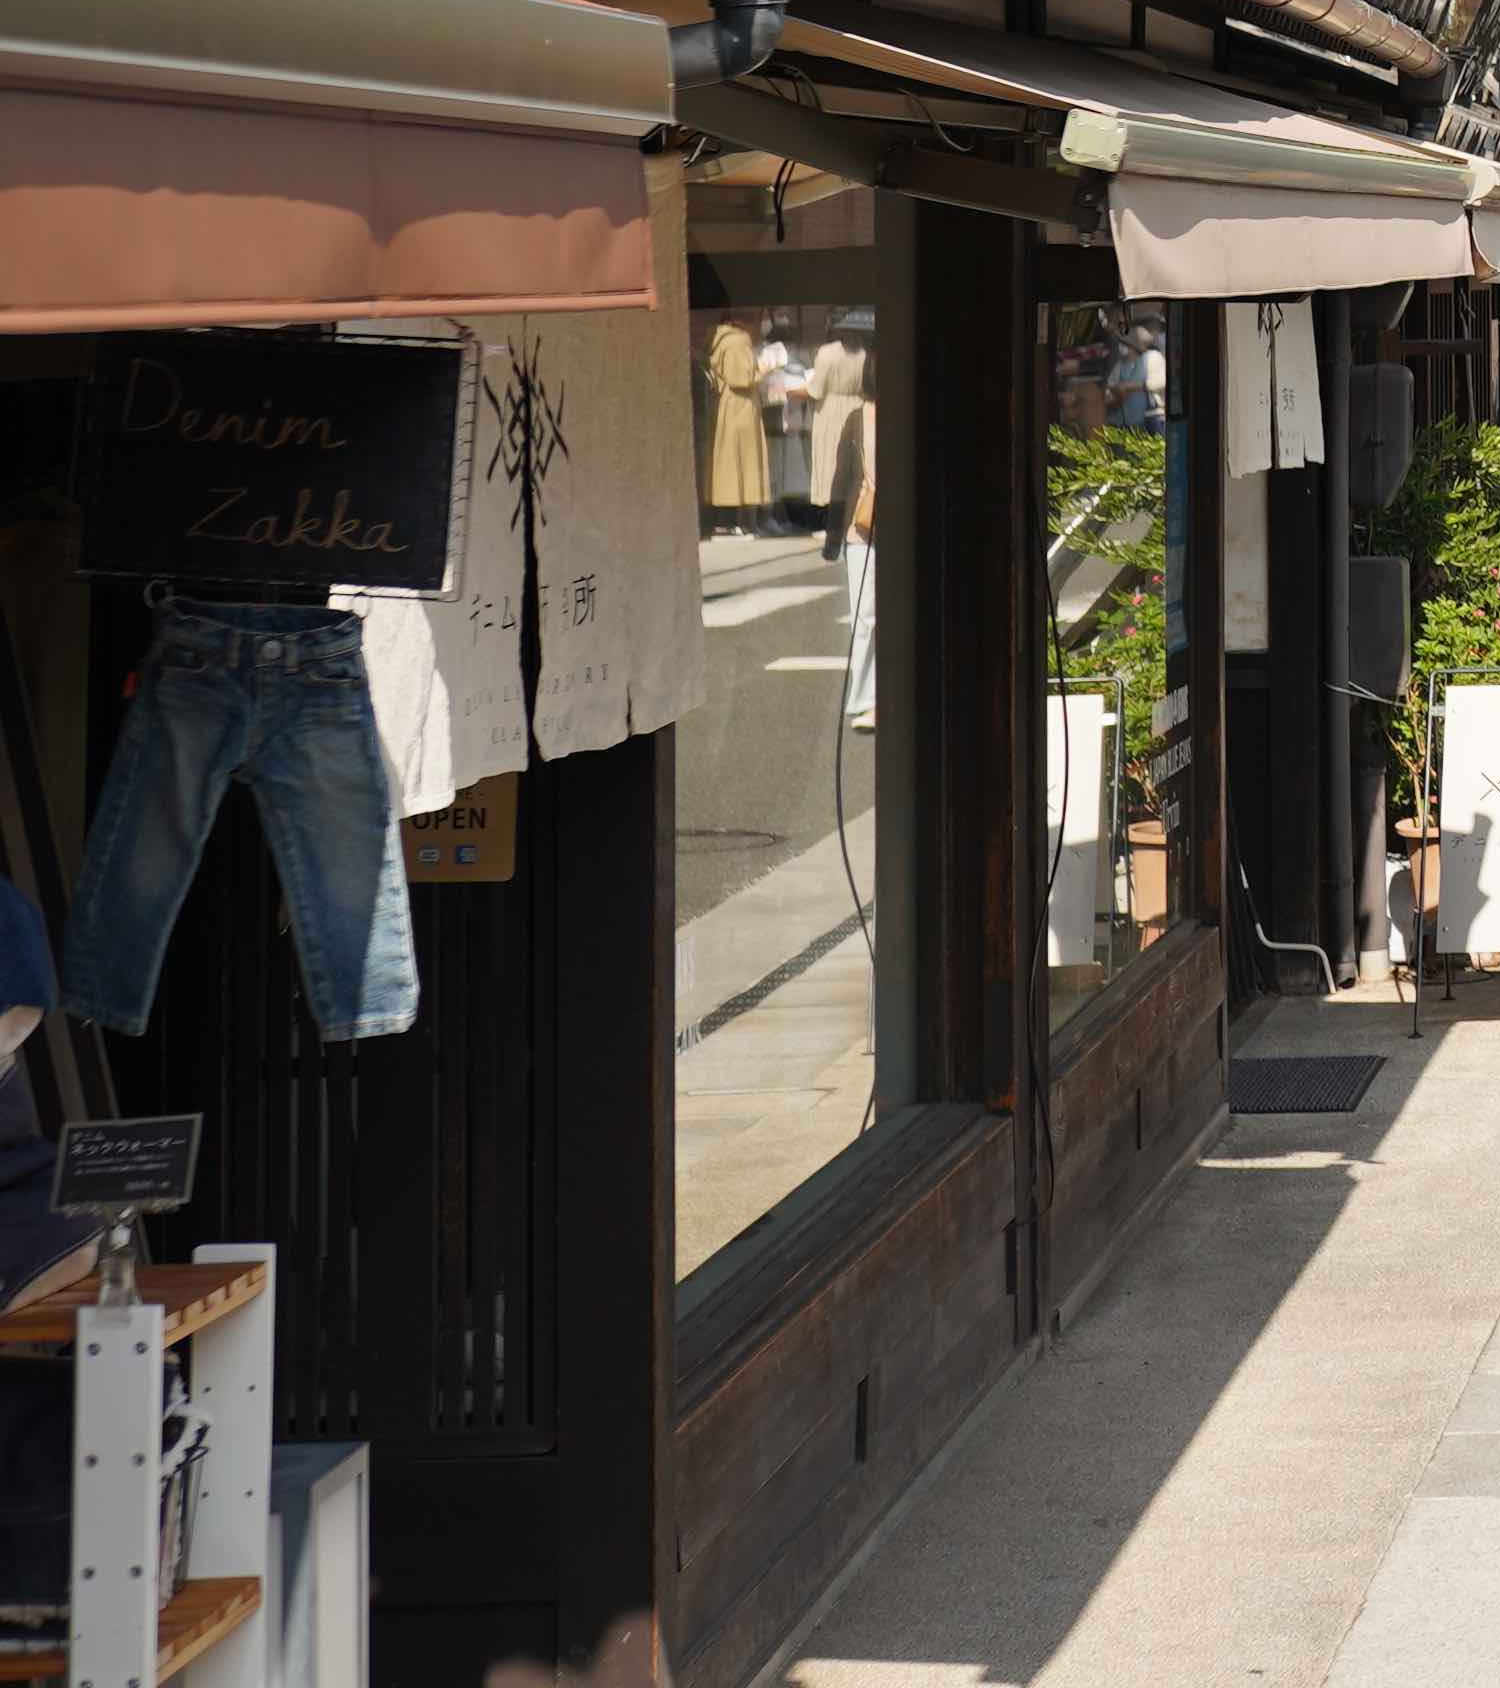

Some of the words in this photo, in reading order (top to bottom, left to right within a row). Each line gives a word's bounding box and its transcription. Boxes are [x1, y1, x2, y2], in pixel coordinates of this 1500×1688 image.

[121, 357, 348, 449] Denim
[186, 487, 409, 553] Zakka
[412, 808, 488, 830] OPEN
